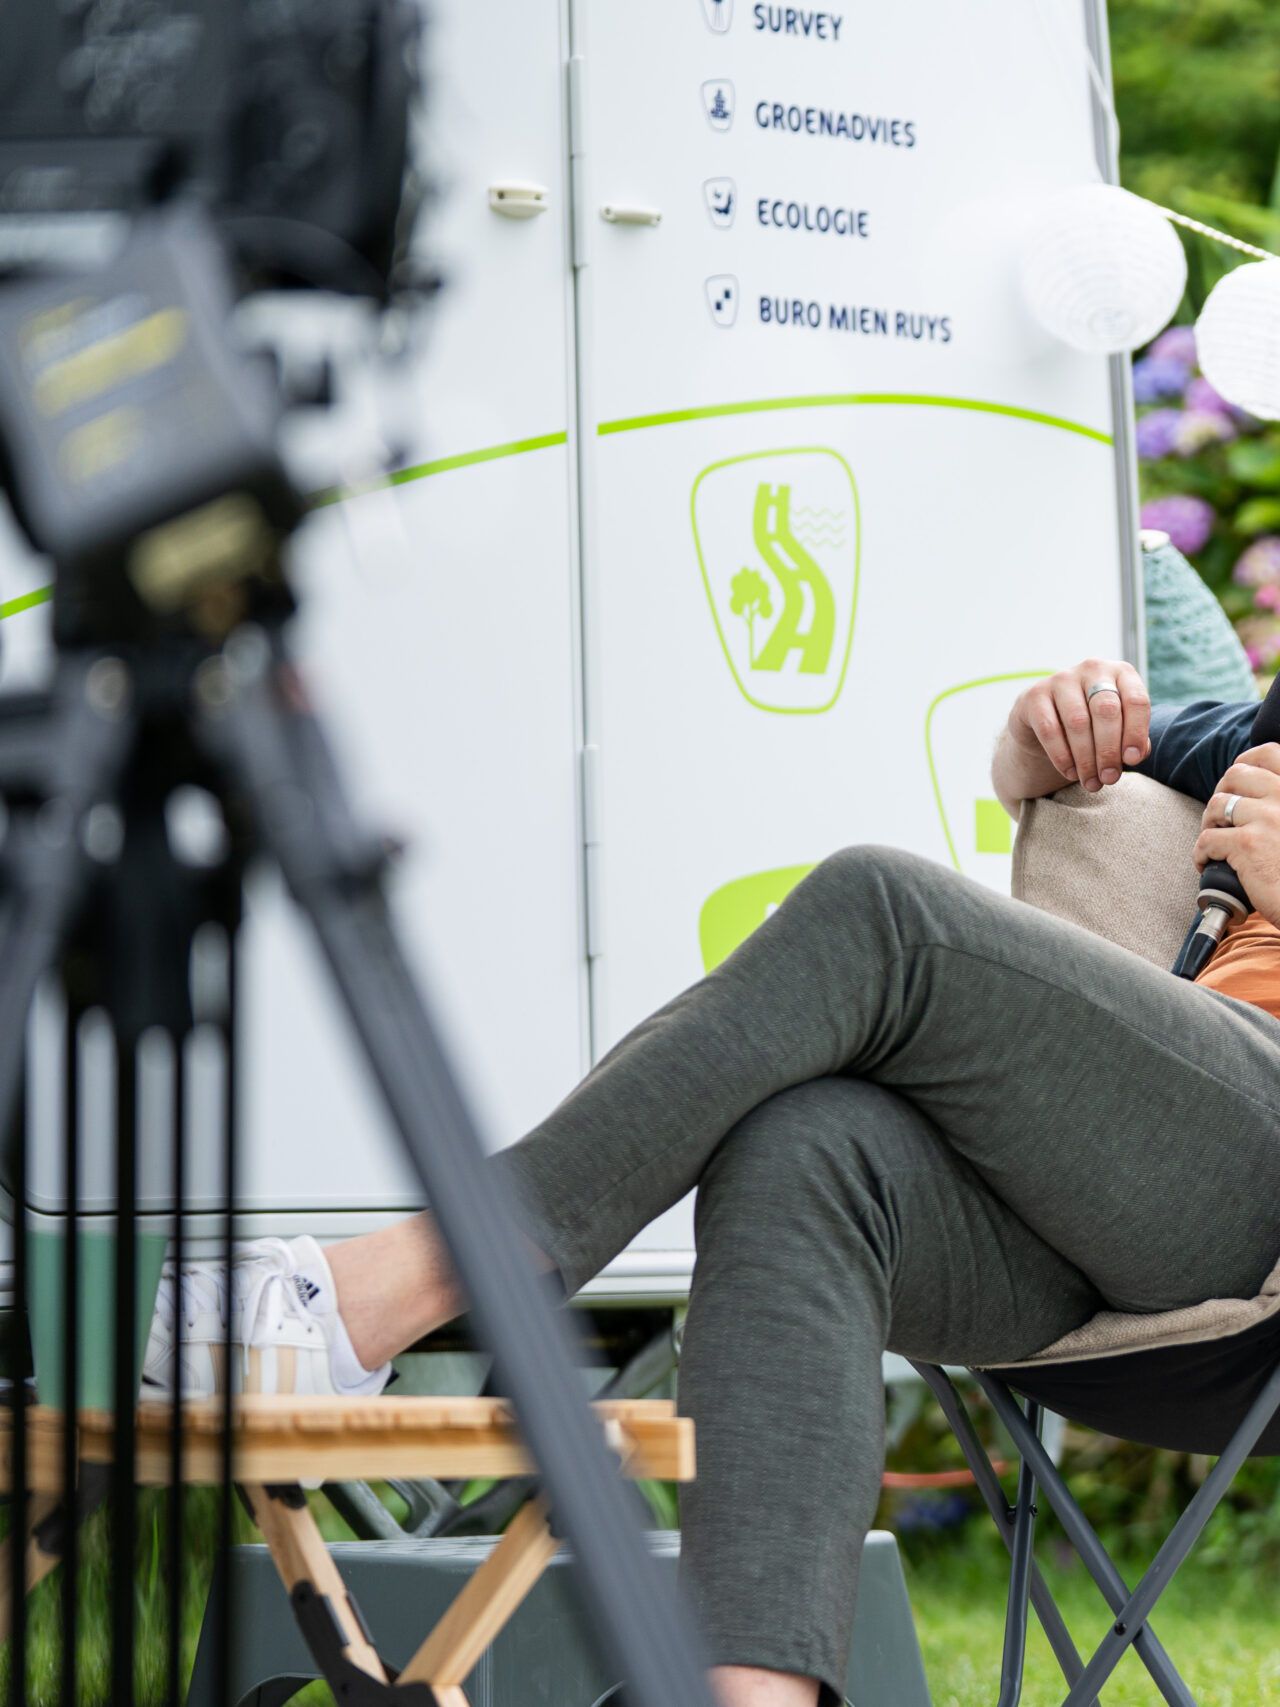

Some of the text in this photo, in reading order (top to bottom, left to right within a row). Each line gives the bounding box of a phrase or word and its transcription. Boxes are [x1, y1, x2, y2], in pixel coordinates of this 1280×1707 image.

[753, 4, 842, 40] SURVEY
[755, 101, 915, 148] GROENADVIES
[757, 198, 869, 237] ECOLOGIE
[759, 296, 951, 342] BURO MIEN RUYS
